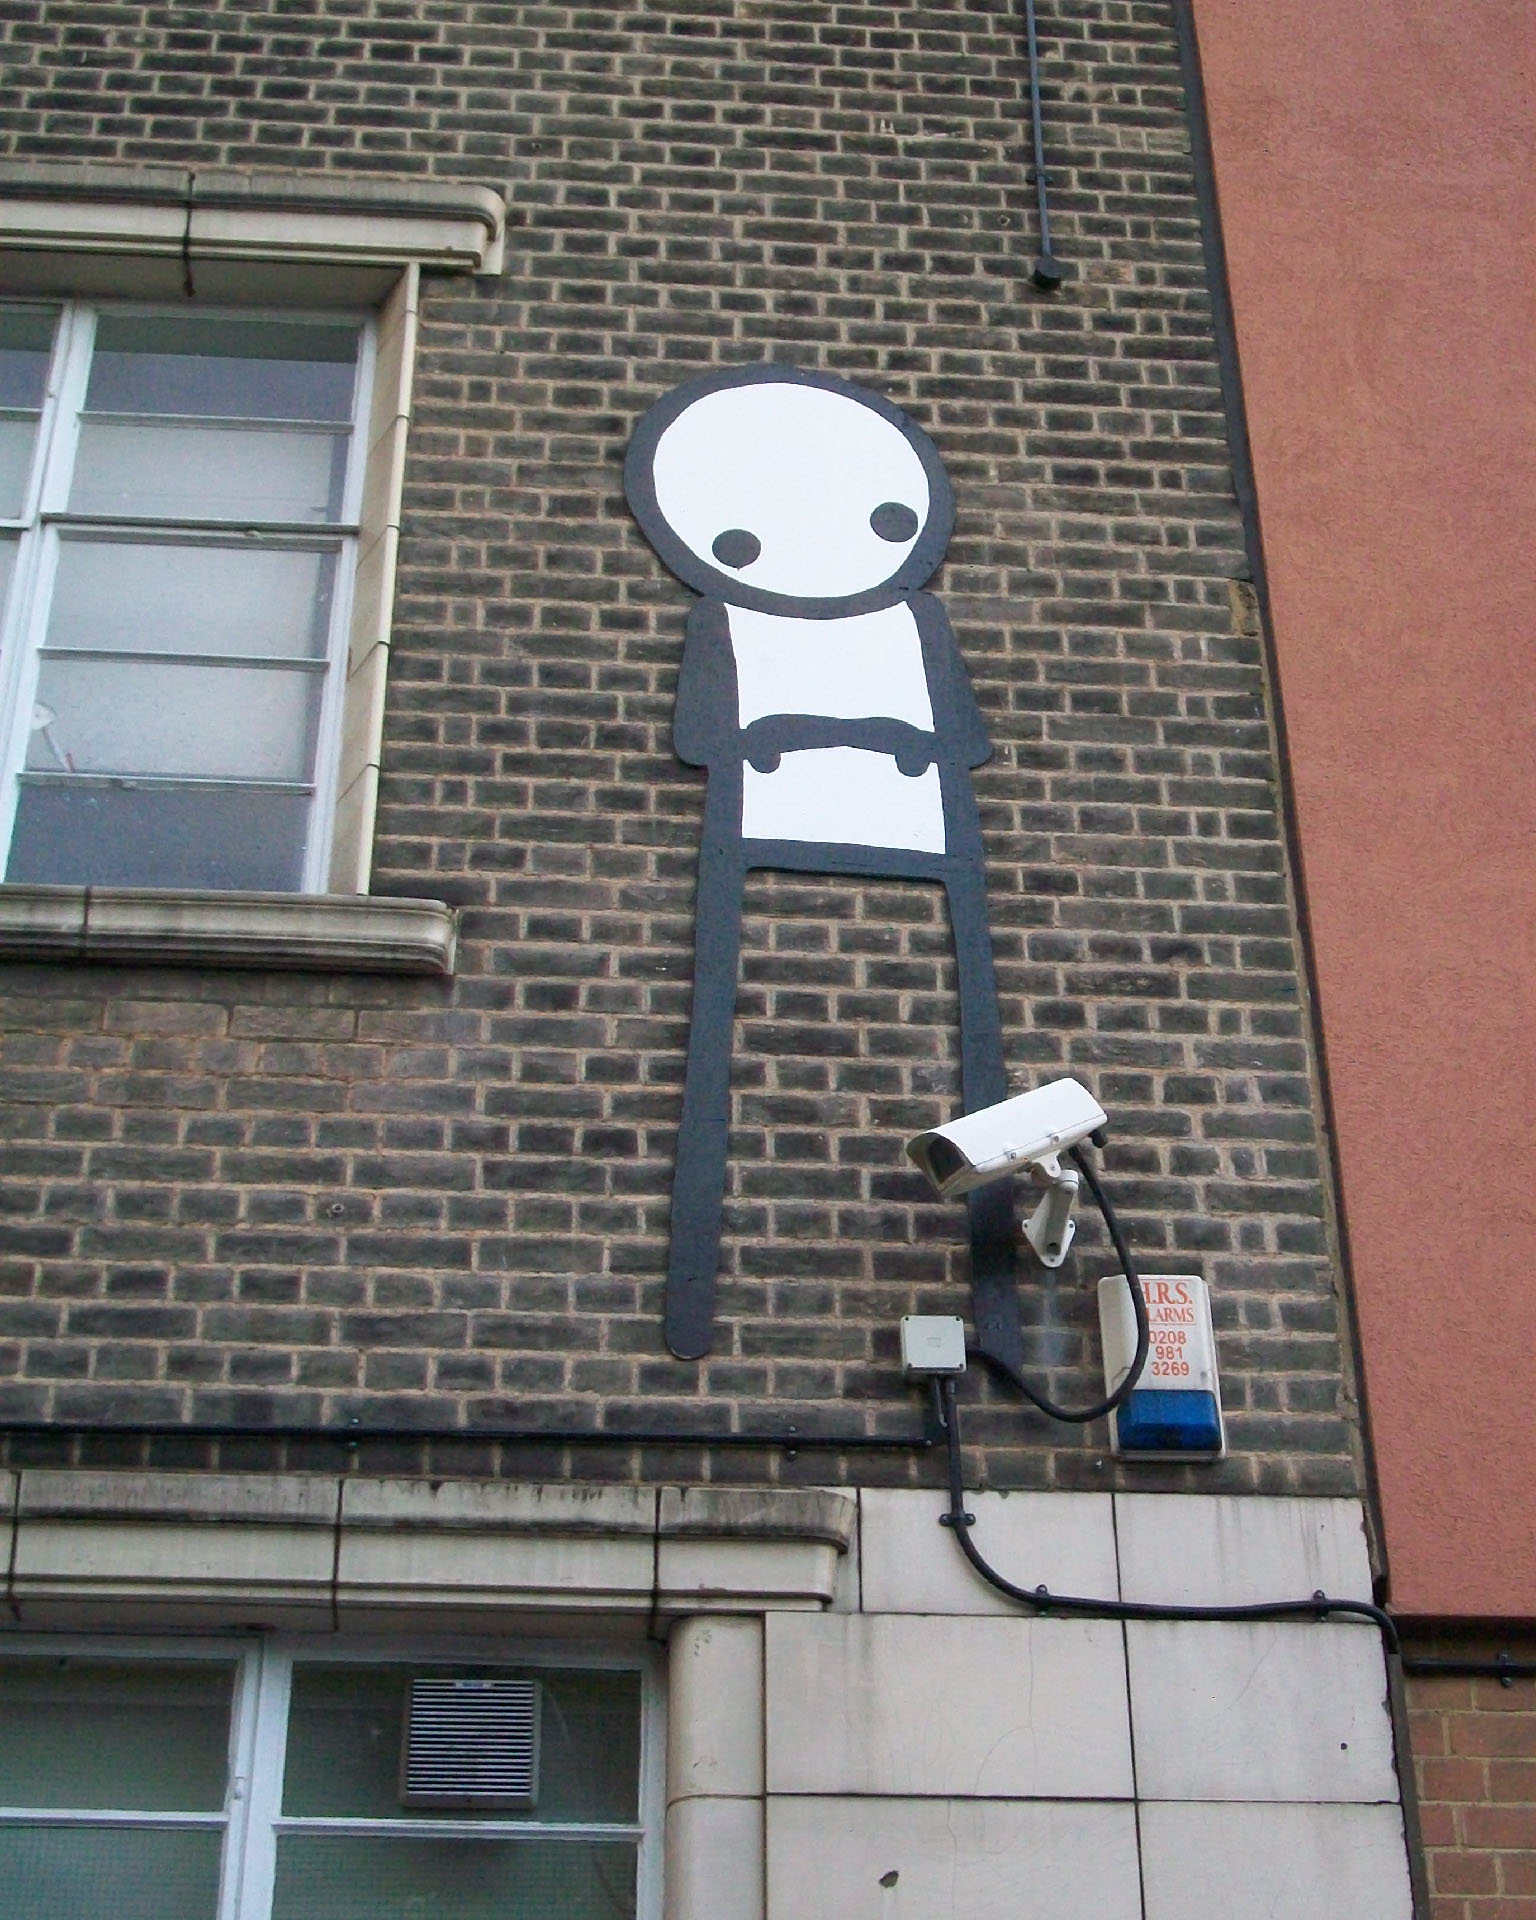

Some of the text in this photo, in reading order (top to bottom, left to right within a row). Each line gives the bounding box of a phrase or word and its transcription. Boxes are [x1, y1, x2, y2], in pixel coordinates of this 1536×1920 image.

[1145, 1307, 1194, 1322] LARMS
[1148, 1331, 1187, 1344] 0208
[1155, 1346, 1183, 1360] 981
[1152, 1361, 1189, 1376] 3269
